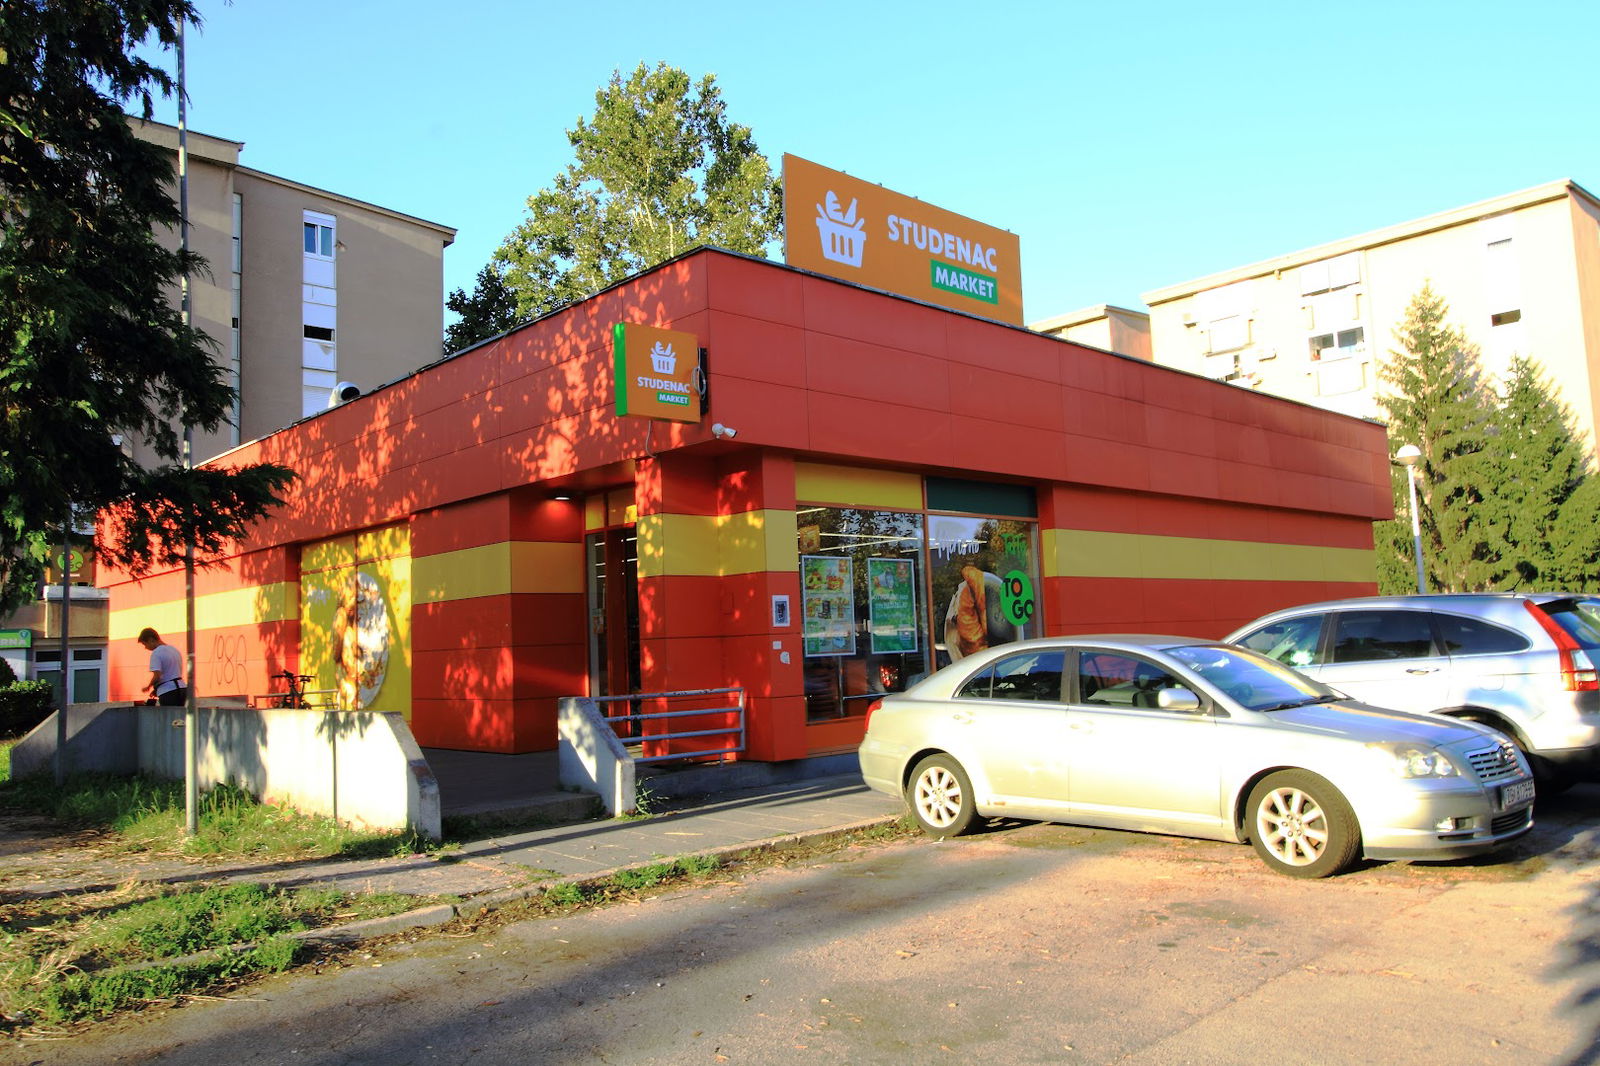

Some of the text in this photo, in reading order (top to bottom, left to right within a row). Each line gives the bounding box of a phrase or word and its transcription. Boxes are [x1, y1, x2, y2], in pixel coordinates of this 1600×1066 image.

[887, 215, 998, 272] STUDENAC
[935, 266, 994, 298] MARKET
[637, 376, 690, 394] STUDENAC
[659, 393, 689, 404] MARKET
[1003, 578, 1023, 597] TO
[1012, 599, 1034, 619] GO
